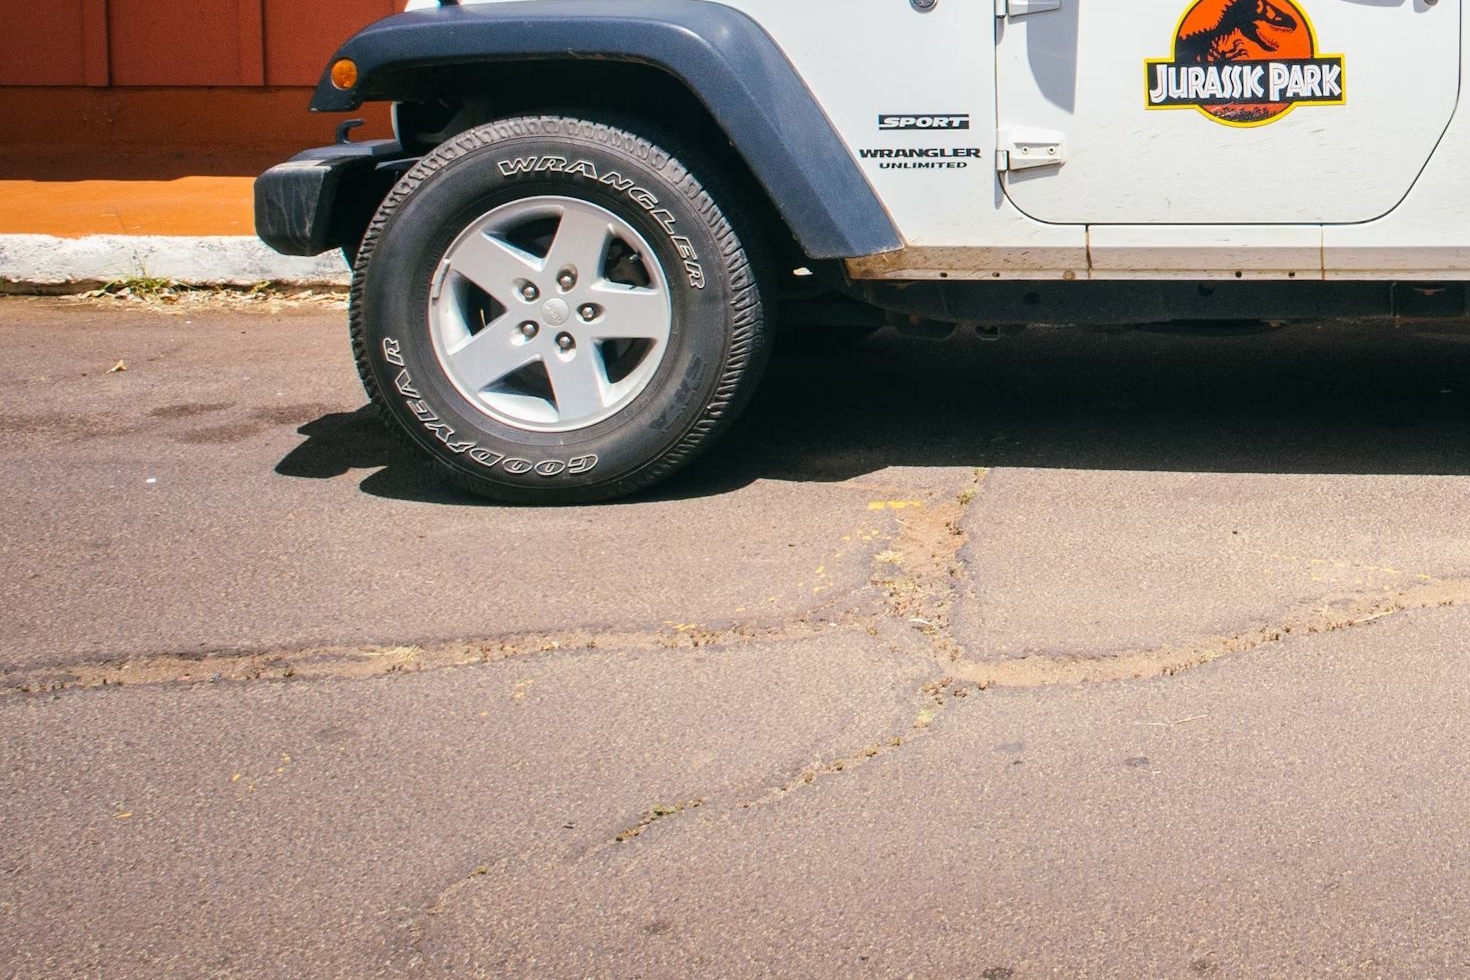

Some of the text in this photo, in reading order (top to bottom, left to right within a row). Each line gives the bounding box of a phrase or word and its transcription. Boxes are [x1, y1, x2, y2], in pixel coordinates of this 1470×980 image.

[1149, 62, 1342, 103] JURASSIC PARK
[879, 115, 969, 129] SPORT
[859, 147, 982, 158] WRANGLER
[879, 161, 968, 170] UNLIMITED
[498, 156, 706, 290] WRANGLER
[383, 337, 599, 477] GOODYEAR
